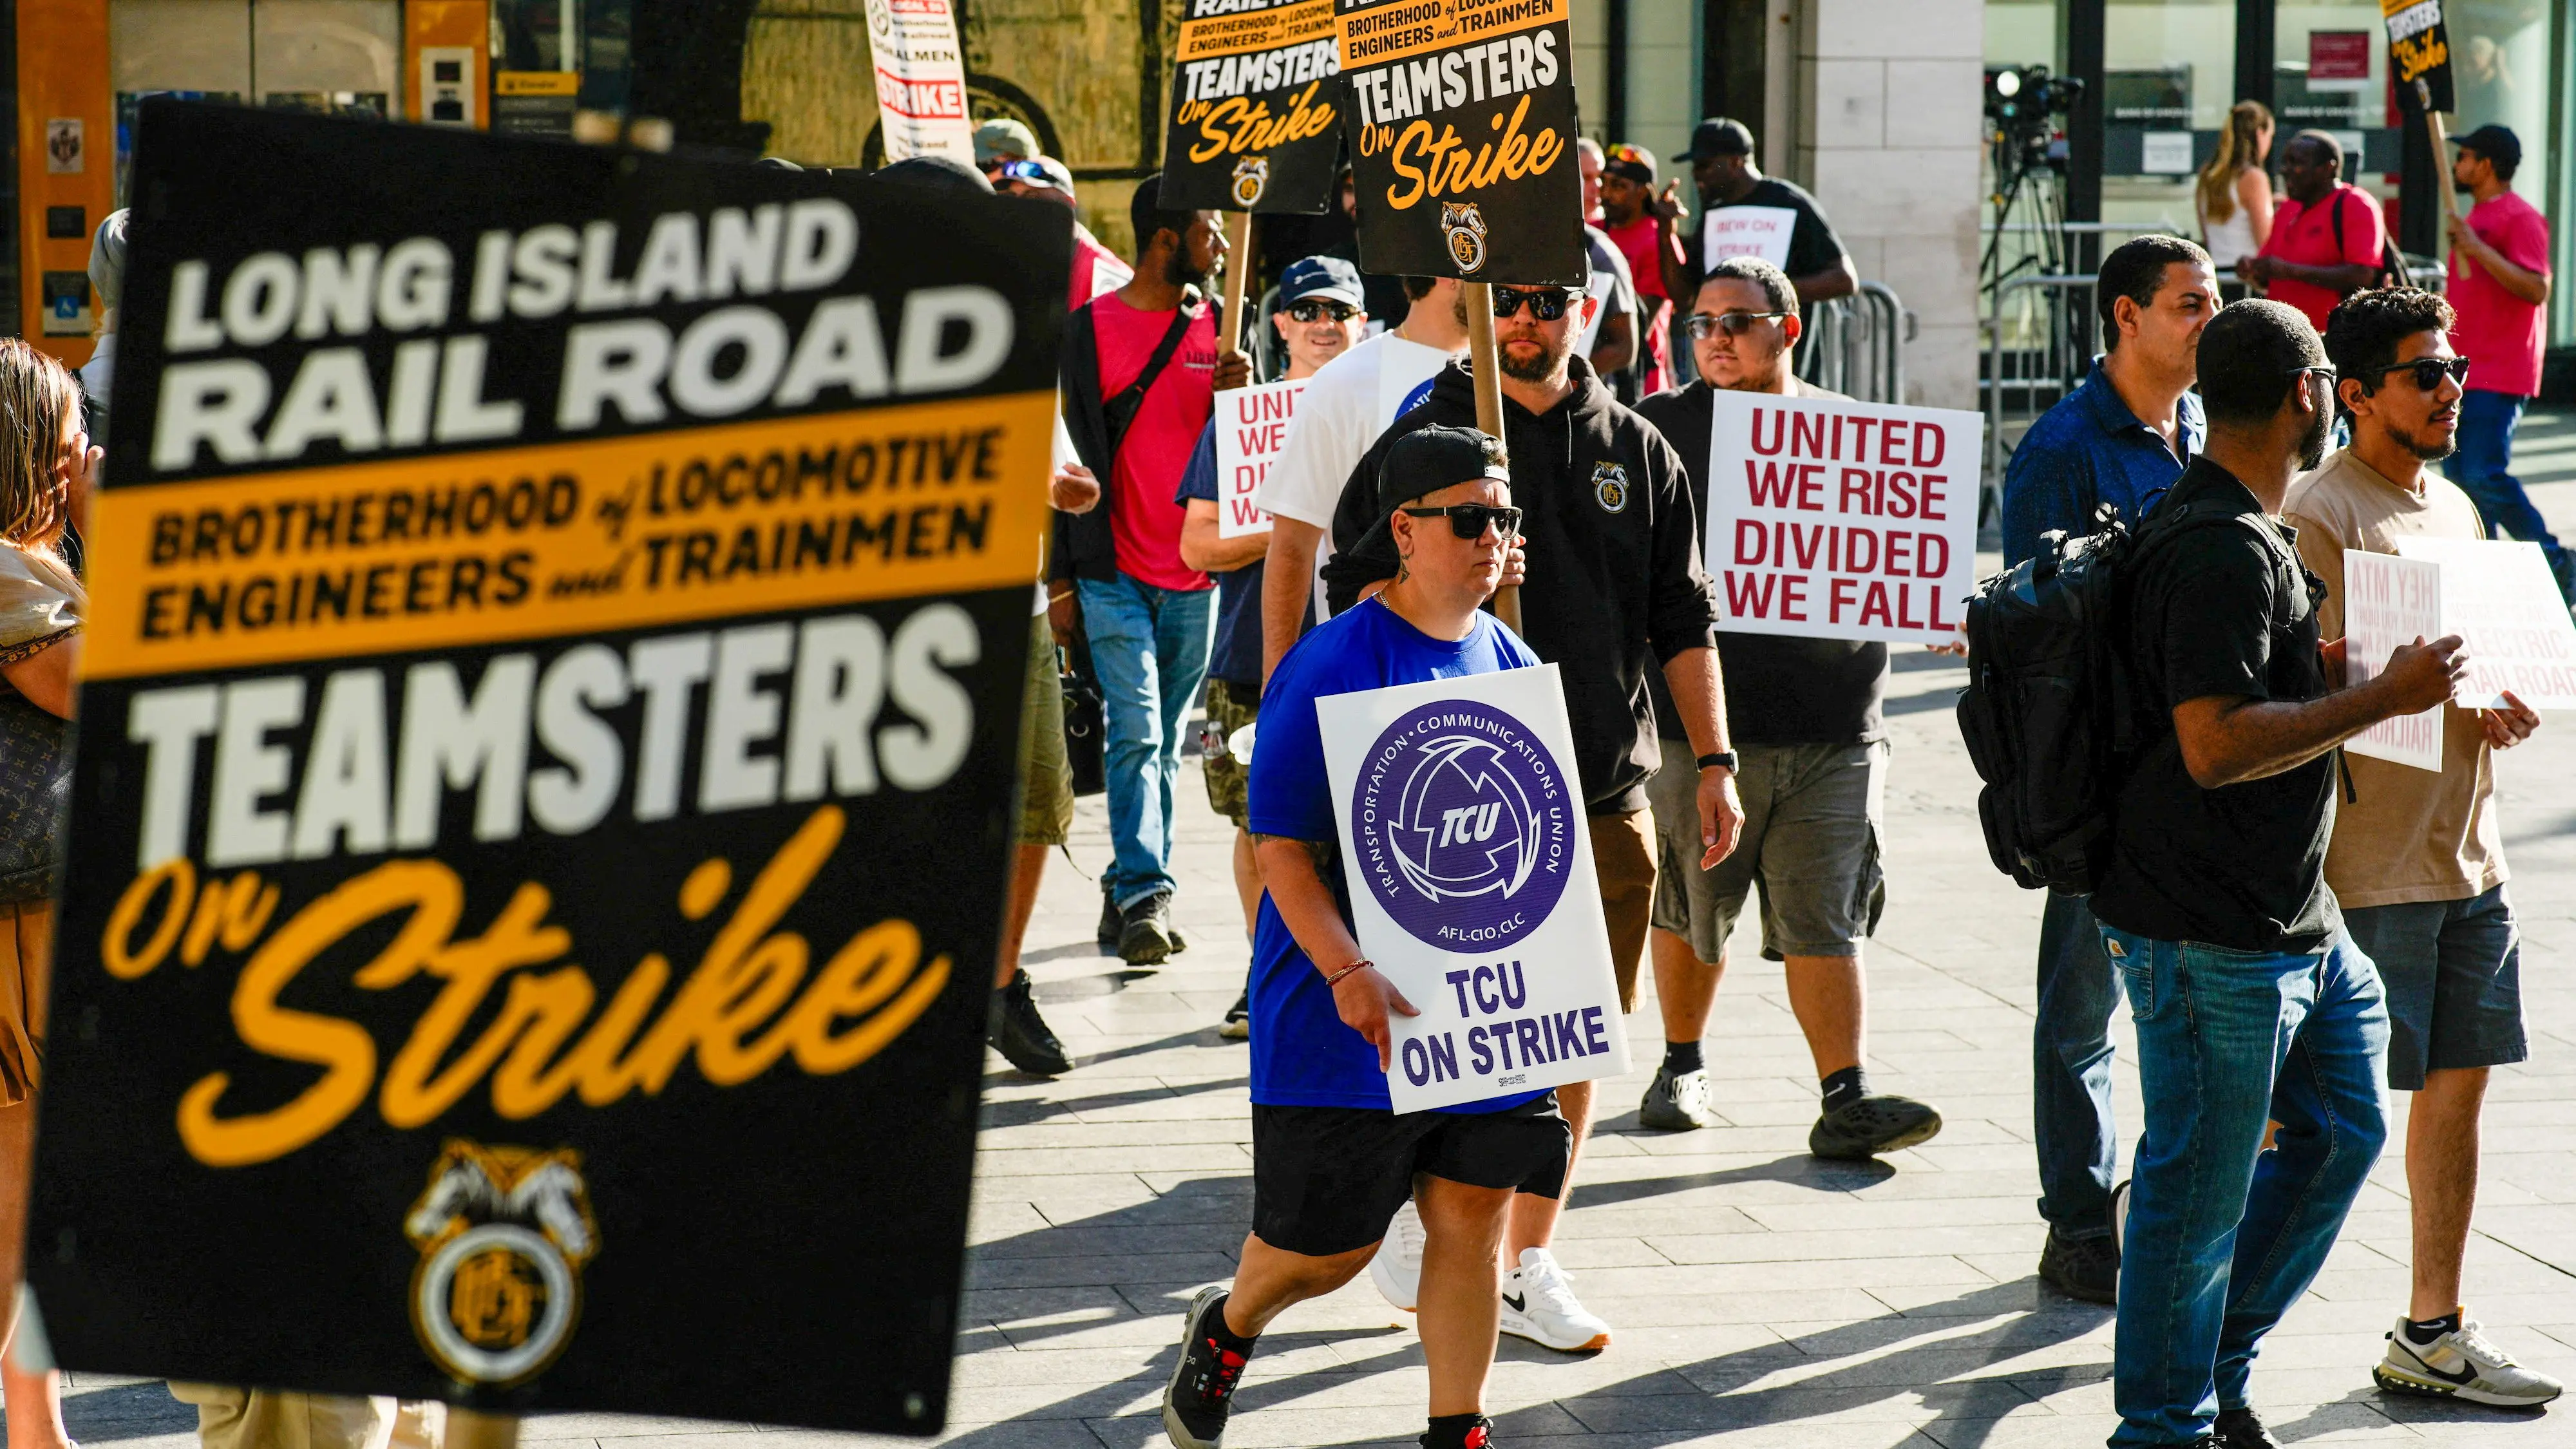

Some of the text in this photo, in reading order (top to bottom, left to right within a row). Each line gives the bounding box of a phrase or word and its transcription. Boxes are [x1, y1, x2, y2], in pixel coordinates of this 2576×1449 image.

[1189, 31, 1268, 53] ENGINEERS
[1191, 14, 1277, 37] BROTHERHOOD
[1347, 0, 1456, 38] BROTHERHOOD of
[1349, 0, 1554, 60] ENGINEERS and TRAINMEN
[879, 73, 960, 116] STRIKE
[1186, 37, 1341, 102] TEAMSTERS
[1352, 30, 1558, 127] TEAMSTERS
[1177, 80, 1336, 164] On Strike
[1360, 94, 1564, 210] On Strike
[167, 200, 858, 354] LONG ISLAND
[153, 287, 1014, 468] RAIL ROAD
[1238, 423, 1285, 457] WE
[1750, 408, 1945, 470] UNITED
[148, 433, 1001, 569] BROTHERHOOD of LOCOMOTIVE
[1236, 463, 1273, 495] DI
[1746, 460, 1947, 521] WE RISE
[1231, 497, 1273, 527] W
[142, 507, 989, 638] ENGINEERS and TRAINMEN
[1734, 519, 1949, 580] DIVIDED
[1724, 571, 1955, 631] WE FALL
[2447, 626, 2568, 659] LECTRIC
[131, 608, 975, 868] TEAMSTERS
[1363, 714, 1564, 899] TRANSPORTATION COMMUNICATIONS UNION
[1439, 802, 1501, 848] TCU
[105, 806, 950, 1164] On Strike
[1446, 960, 1526, 1018] TCU
[1402, 1005, 1609, 1086] ON STRIKE
